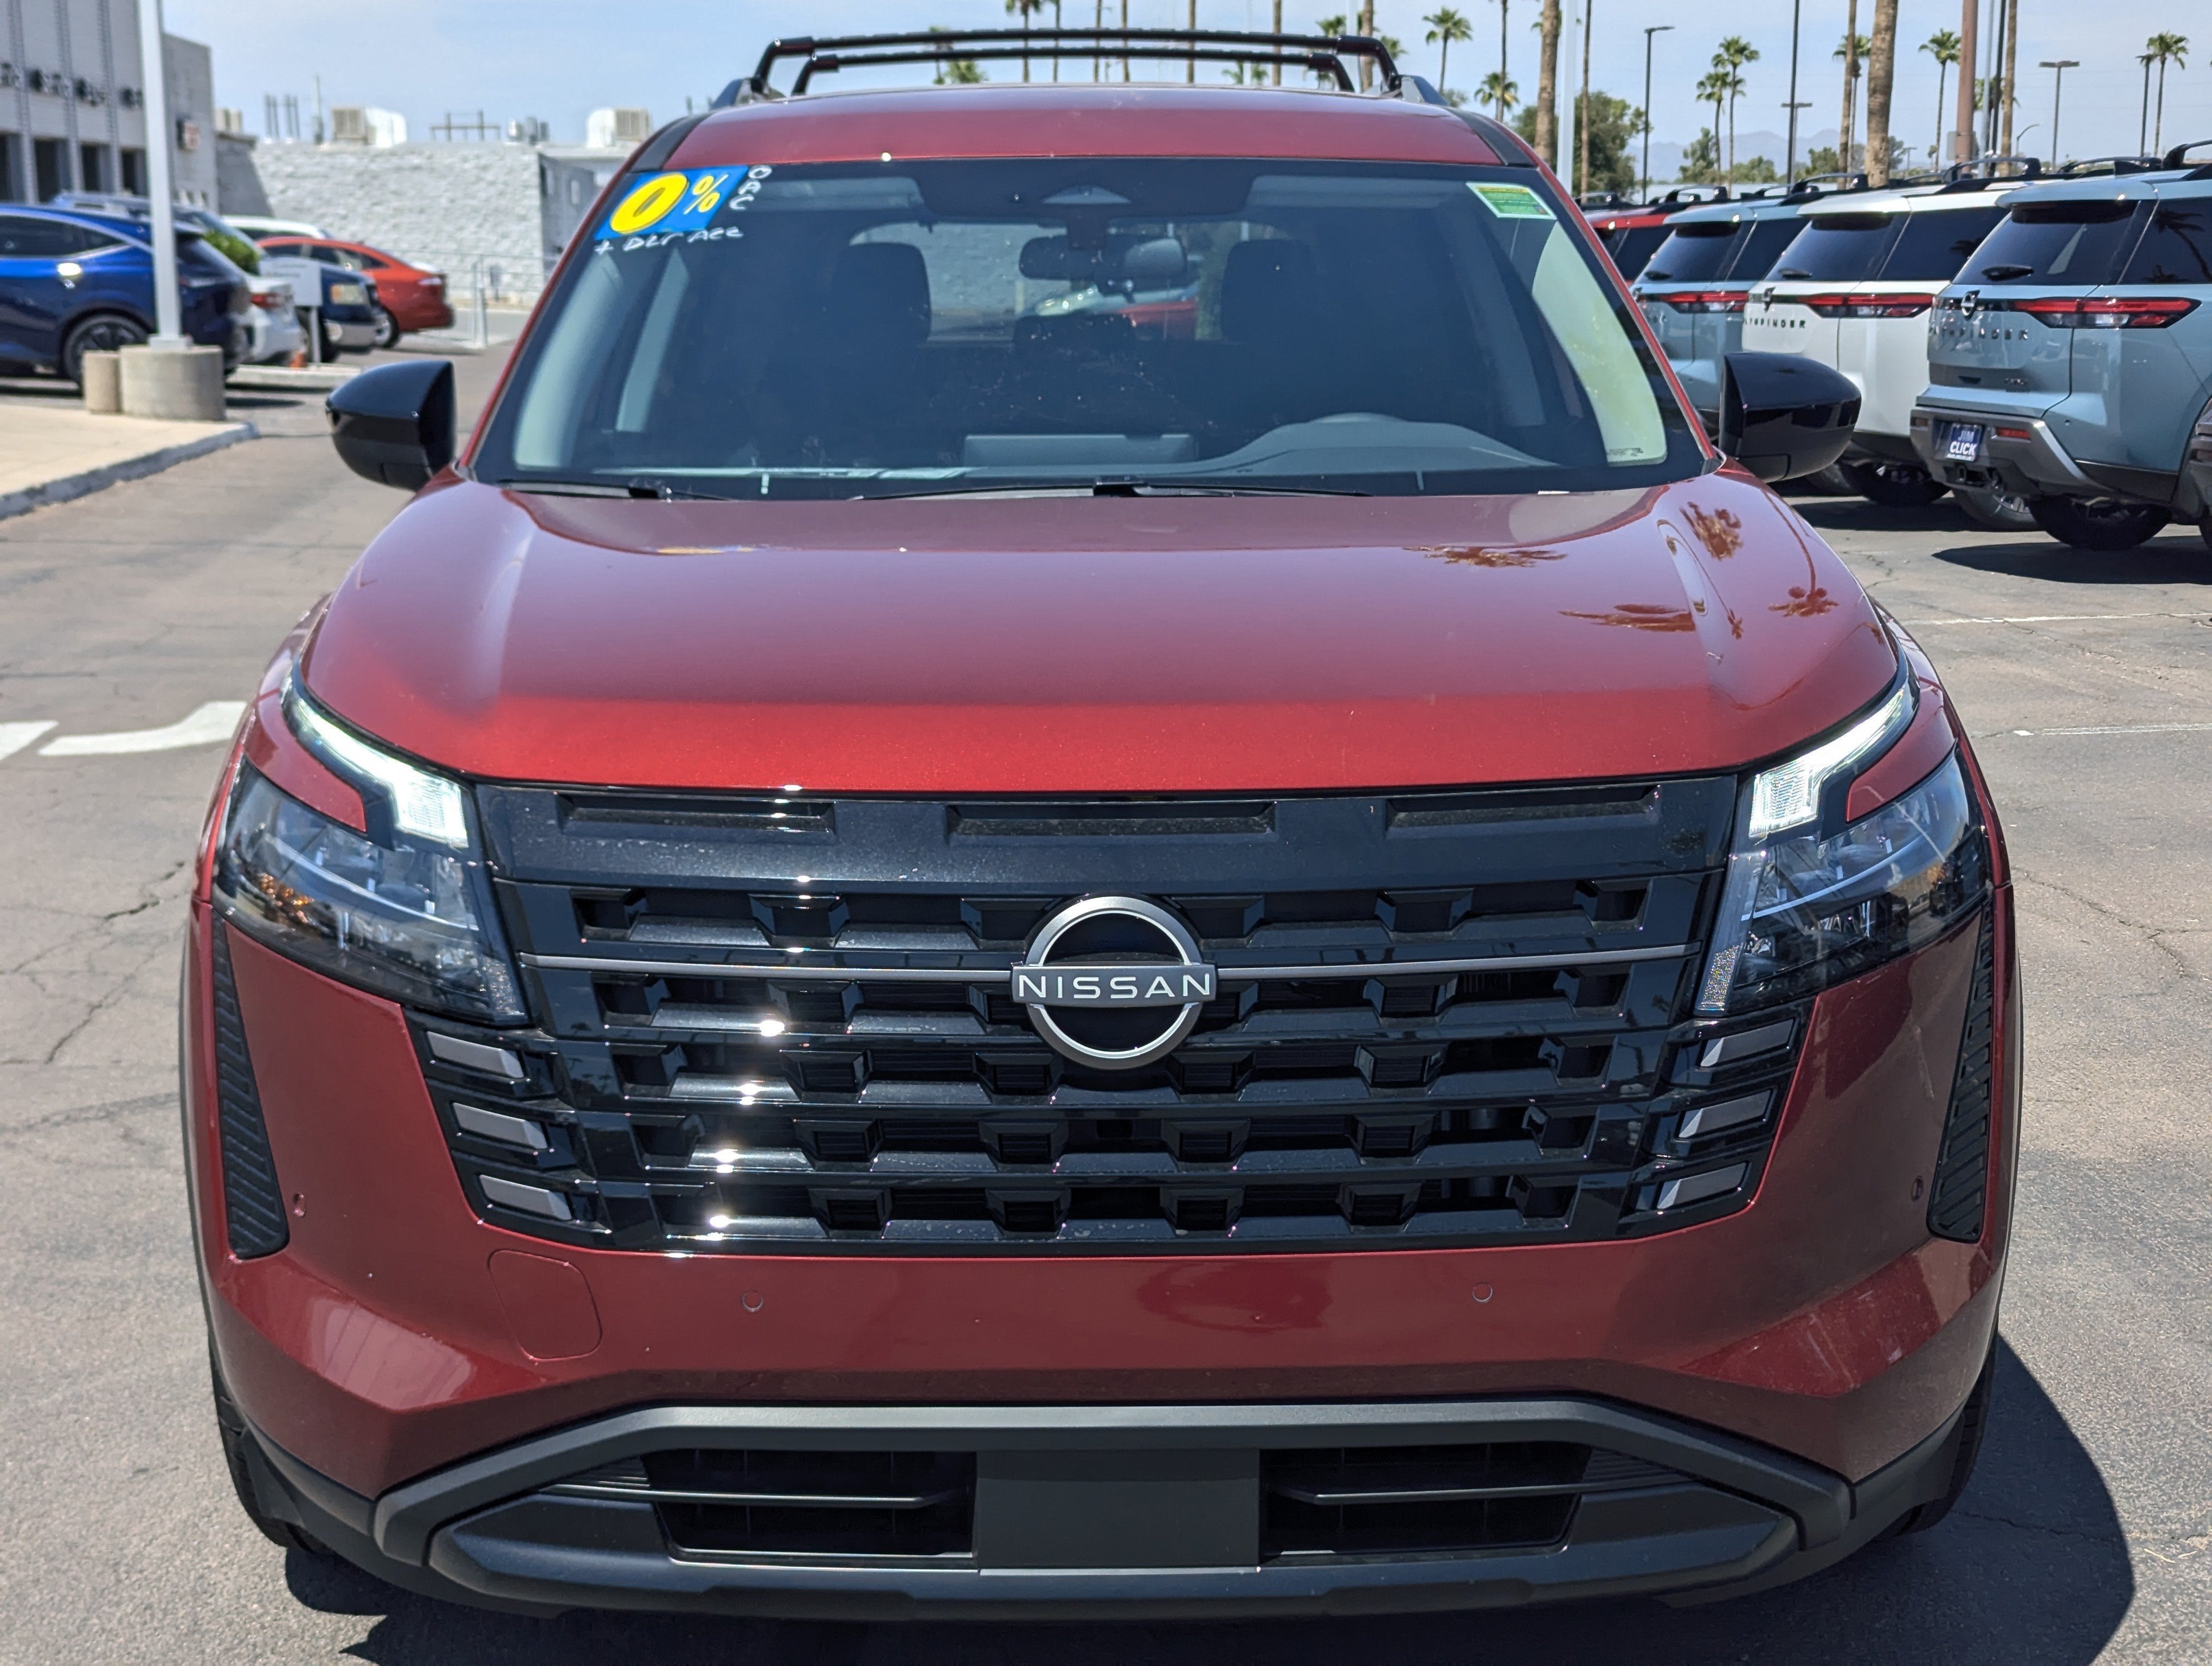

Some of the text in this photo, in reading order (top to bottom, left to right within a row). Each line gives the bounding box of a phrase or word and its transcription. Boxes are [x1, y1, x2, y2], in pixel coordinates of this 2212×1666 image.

[609, 172, 729, 234] 0%
[1958, 430, 1975, 442] JIM
[1950, 440, 1978, 456] CLICK
[1019, 973, 1210, 999] NISSAN
